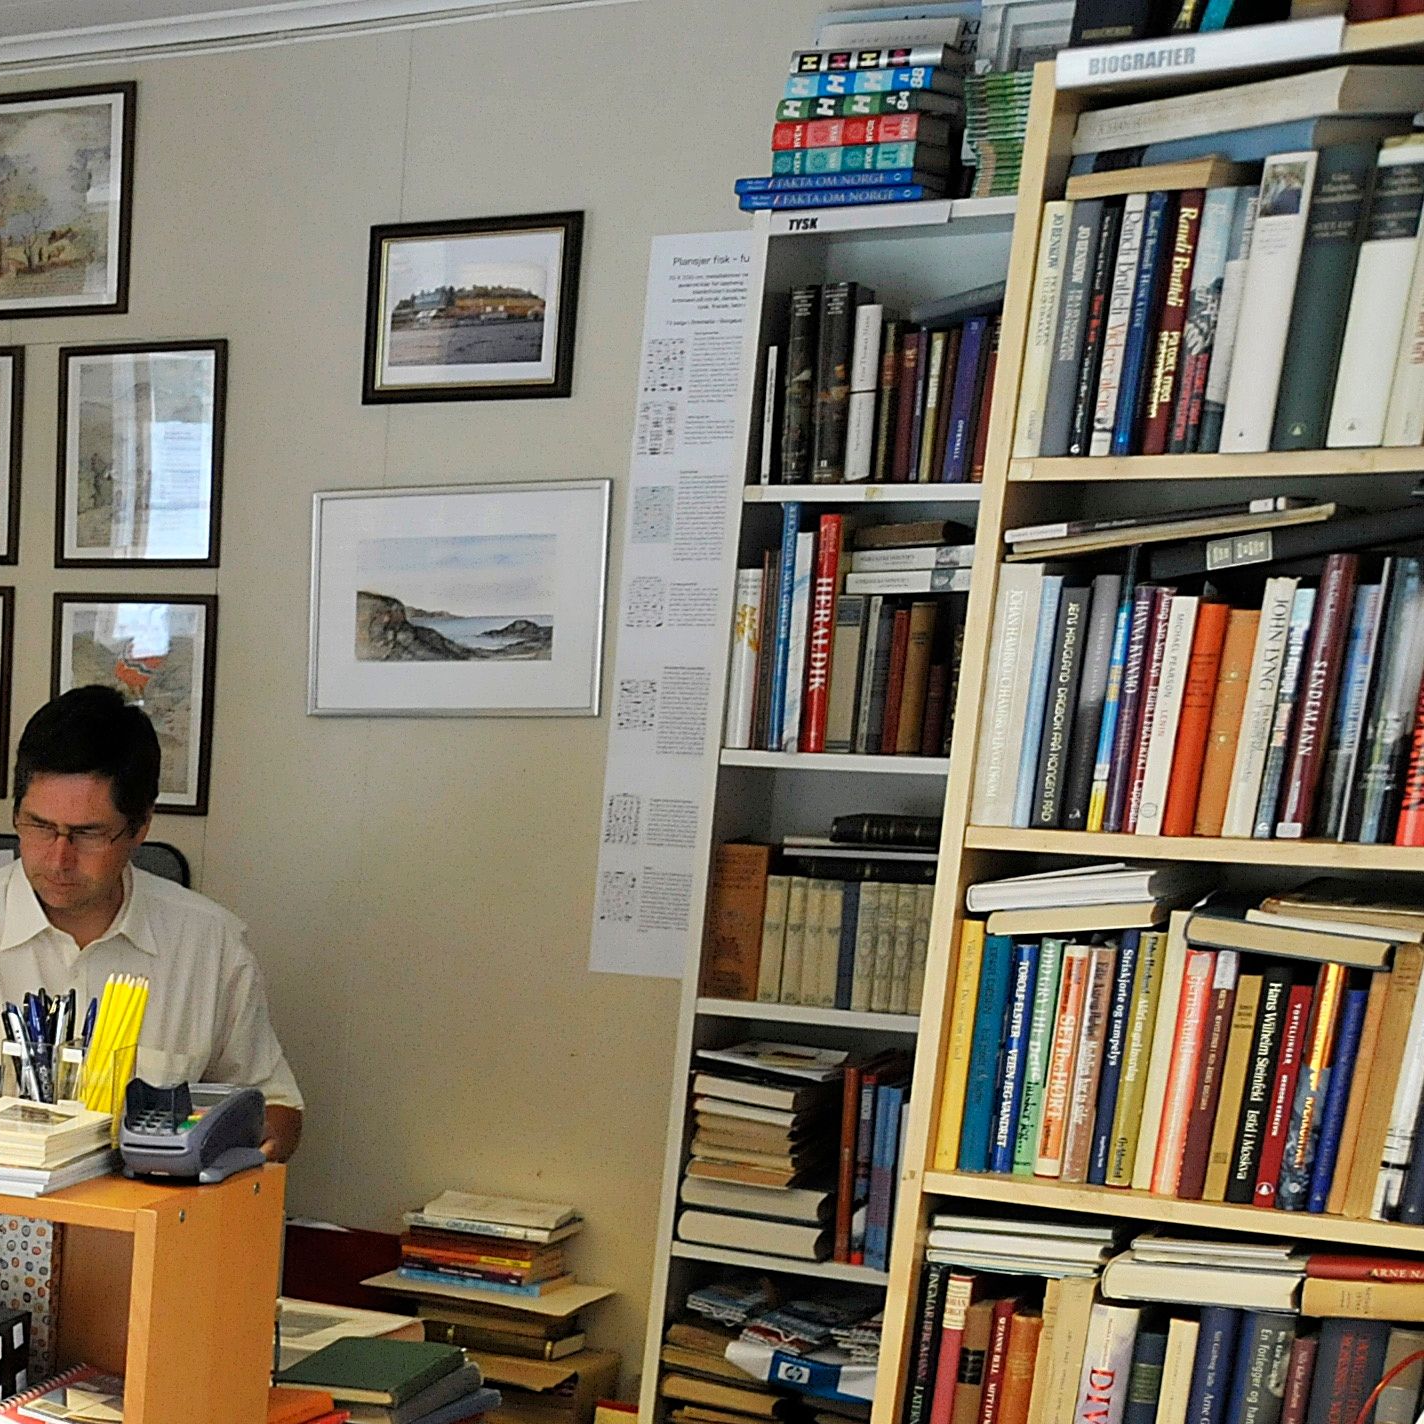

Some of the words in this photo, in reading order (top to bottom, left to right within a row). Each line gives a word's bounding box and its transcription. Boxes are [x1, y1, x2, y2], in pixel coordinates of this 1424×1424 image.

[1087, 47, 1196, 75] BIOGRAFIER
[789, 217, 819, 231] TYSK
[1173, 205, 1198, 253] Randi
[672, 254, 712, 267] Plansjer
[713, 253, 733, 266] fisk
[1165, 254, 1190, 307] Bratteli
[807, 576, 834, 690] HERALDIK
[1266, 596, 1289, 641] JOHN
[1258, 647, 1280, 691] LYNG
[1296, 658, 1328, 756] SENDEMANN
[1113, 948, 1134, 1002] Striskjorte
[1264, 981, 1281, 1010] Hans
[1110, 1003, 1123, 1017] og
[1104, 1018, 1125, 1066] rampelys
[1257, 1011, 1276, 1055] Wilhelm
[1249, 1056, 1268, 1101] Steinfeld
[1243, 1108, 1259, 1132] Istid
[1235, 1138, 1253, 1180] Moskva
[1259, 1327, 1271, 1340] En
[1248, 1343, 1268, 1387] forlegger
[1245, 1390, 1258, 1403] og
